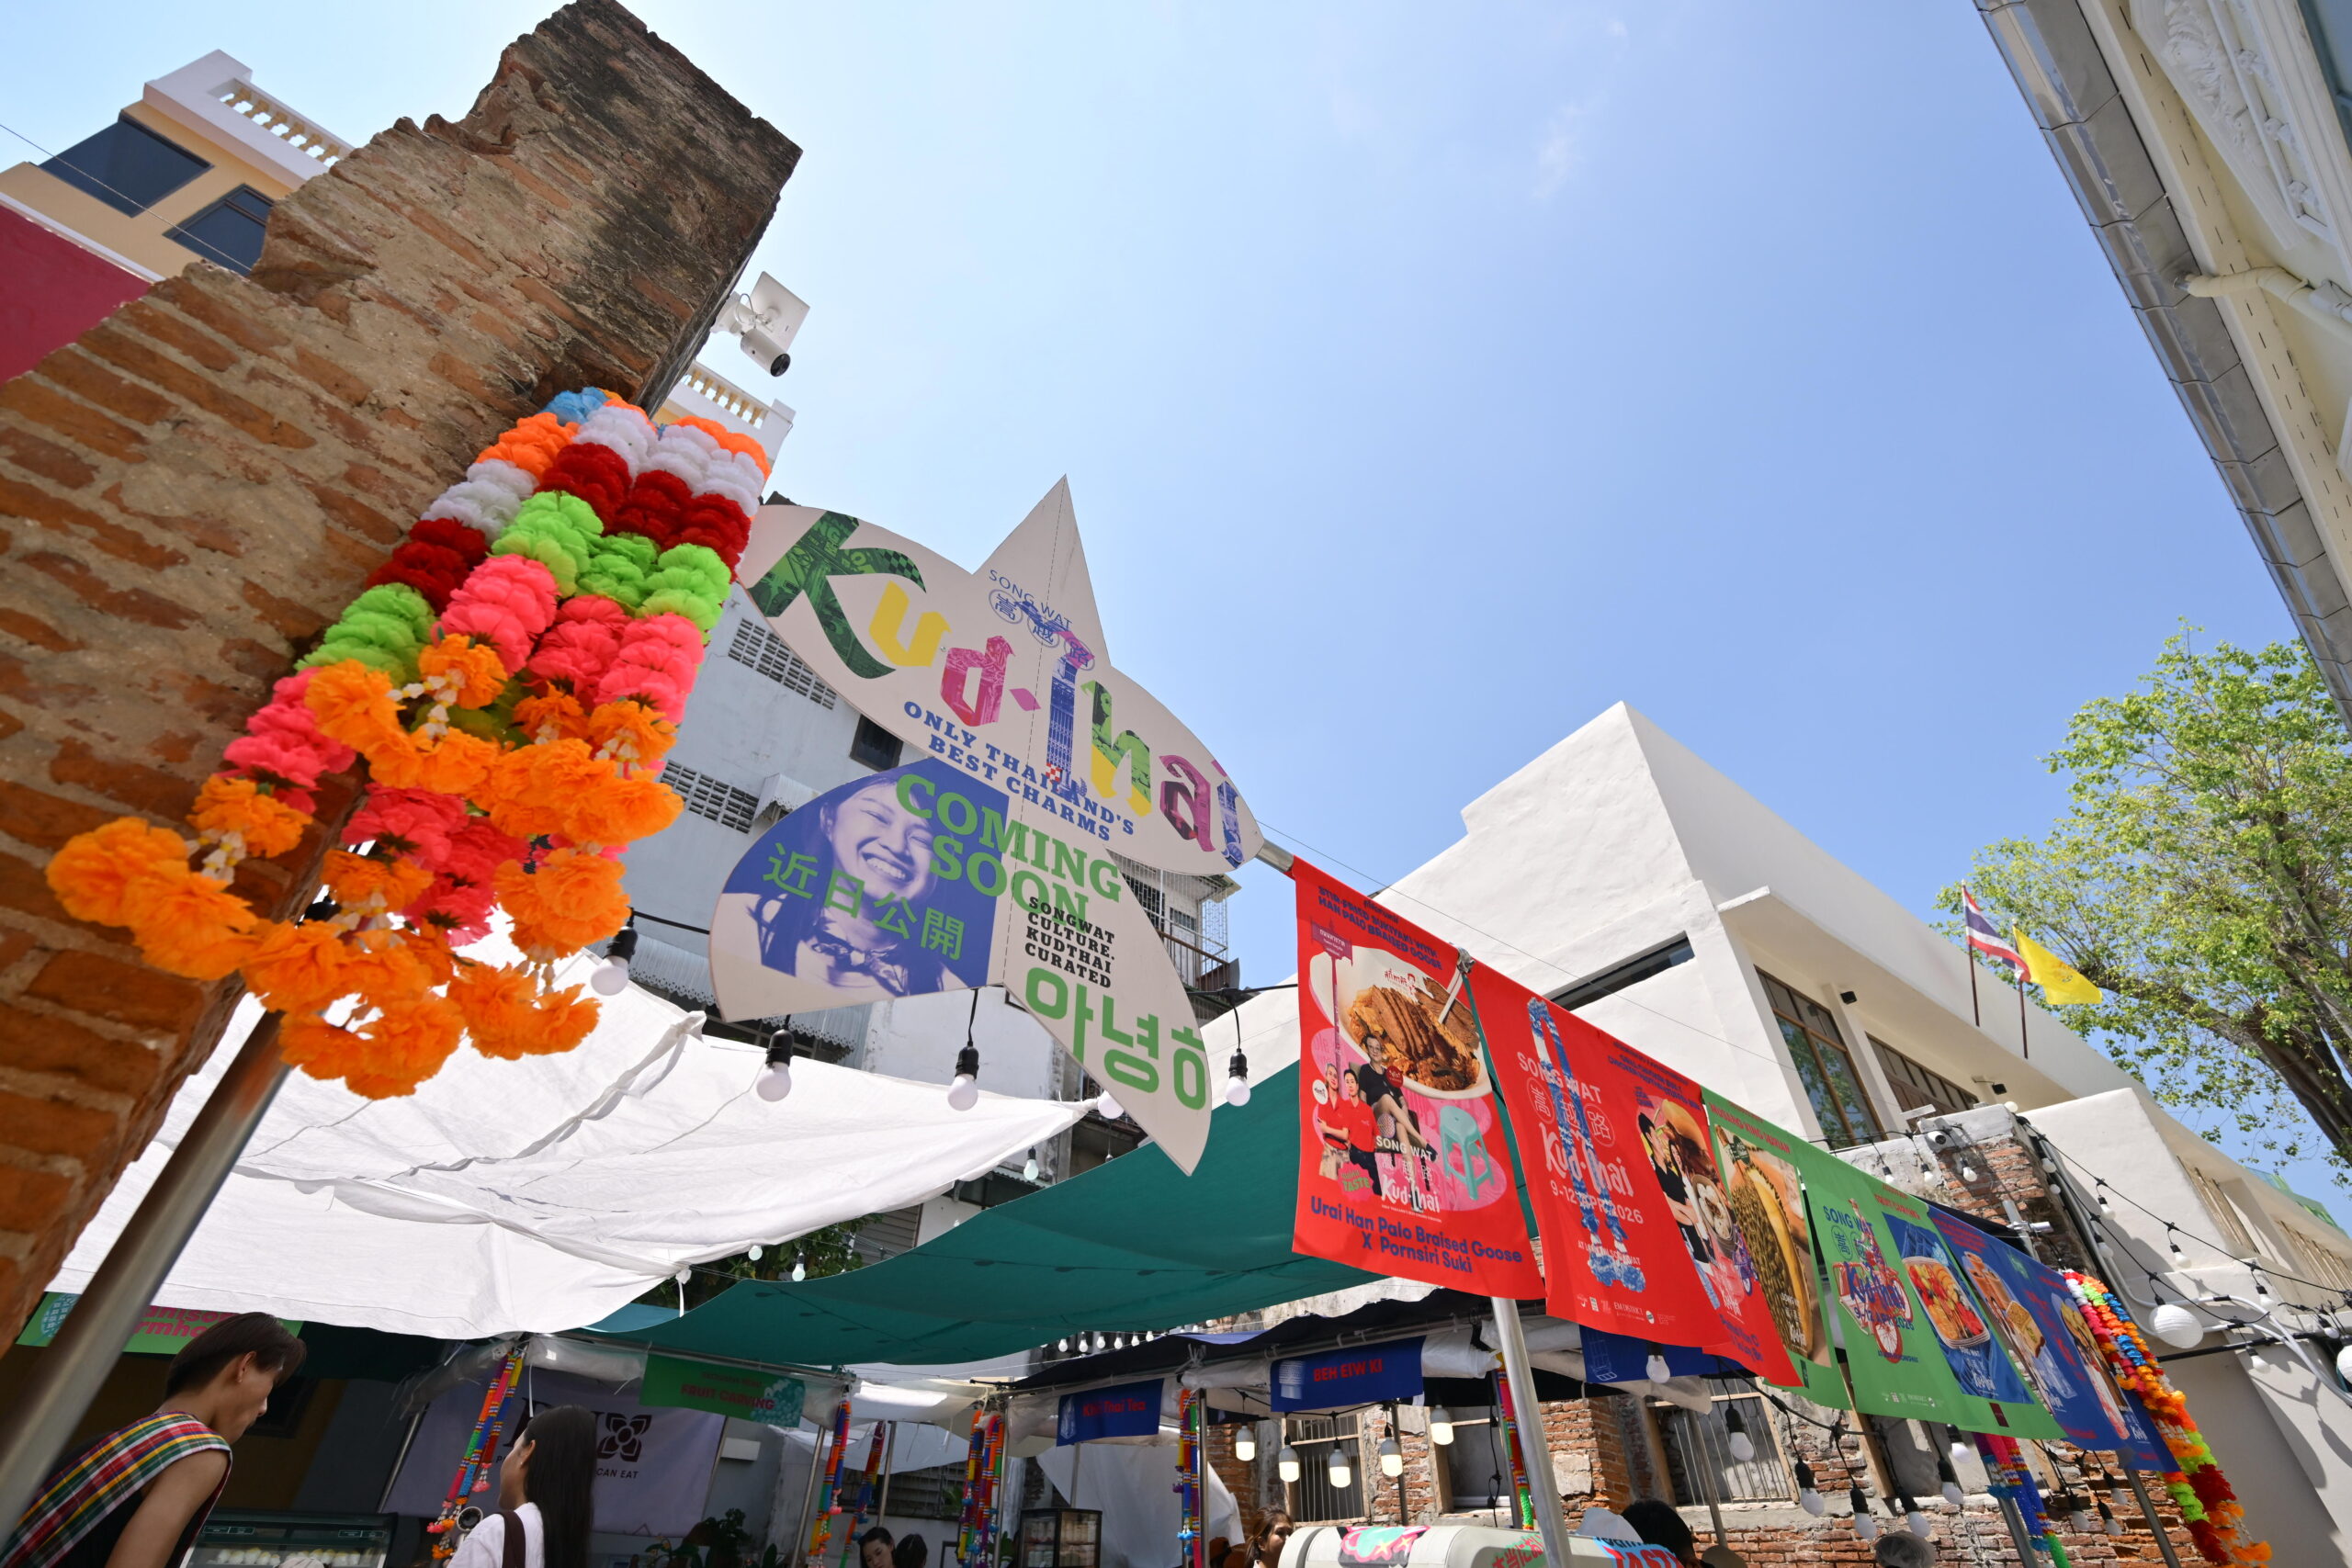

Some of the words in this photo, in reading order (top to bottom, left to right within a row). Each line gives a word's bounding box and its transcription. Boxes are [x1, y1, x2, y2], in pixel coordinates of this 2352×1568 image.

[989, 570, 1035, 606] SONG
[1041, 602, 1072, 631] WAT
[904, 701, 977, 749] ONLY
[986, 742, 1135, 836] THAILAND'S
[928, 734, 998, 781] BEST
[1006, 776, 1110, 841] CHARMS
[896, 773, 1122, 903] COMING
[763, 842, 965, 961] 近日公開
[930, 835, 1090, 934] SOON
[1027, 911, 1115, 960] CULTURE.
[1029, 897, 1114, 944] SONGWAT
[1024, 942, 1111, 988] CURATED
[1026, 926, 1111, 974] KUDTHAI
[1517, 1052, 1564, 1089] SONG
[1564, 1075, 1601, 1104] WAT
[1375, 1135, 1408, 1154] SONG
[1410, 1145, 1433, 1162] WAT
[1310, 1195, 1342, 1221] Urai
[1346, 1206, 1374, 1231] Han
[1377, 1217, 1412, 1239] Palo
[1416, 1226, 1468, 1255] Braised
[1471, 1241, 1523, 1263] Goose
[1823, 1205, 1854, 1229] SONG
[1380, 1235, 1440, 1265] Pornsiri
[1442, 1253, 1473, 1273] Suki
[1313, 1367, 1339, 1382] BEH
[1369, 1359, 1383, 1372] KI
[681, 1383, 716, 1398] FRUIT
[719, 1390, 775, 1410] CARVING
[597, 1468, 616, 1478] CAN
[620, 1471, 639, 1479] EAT
